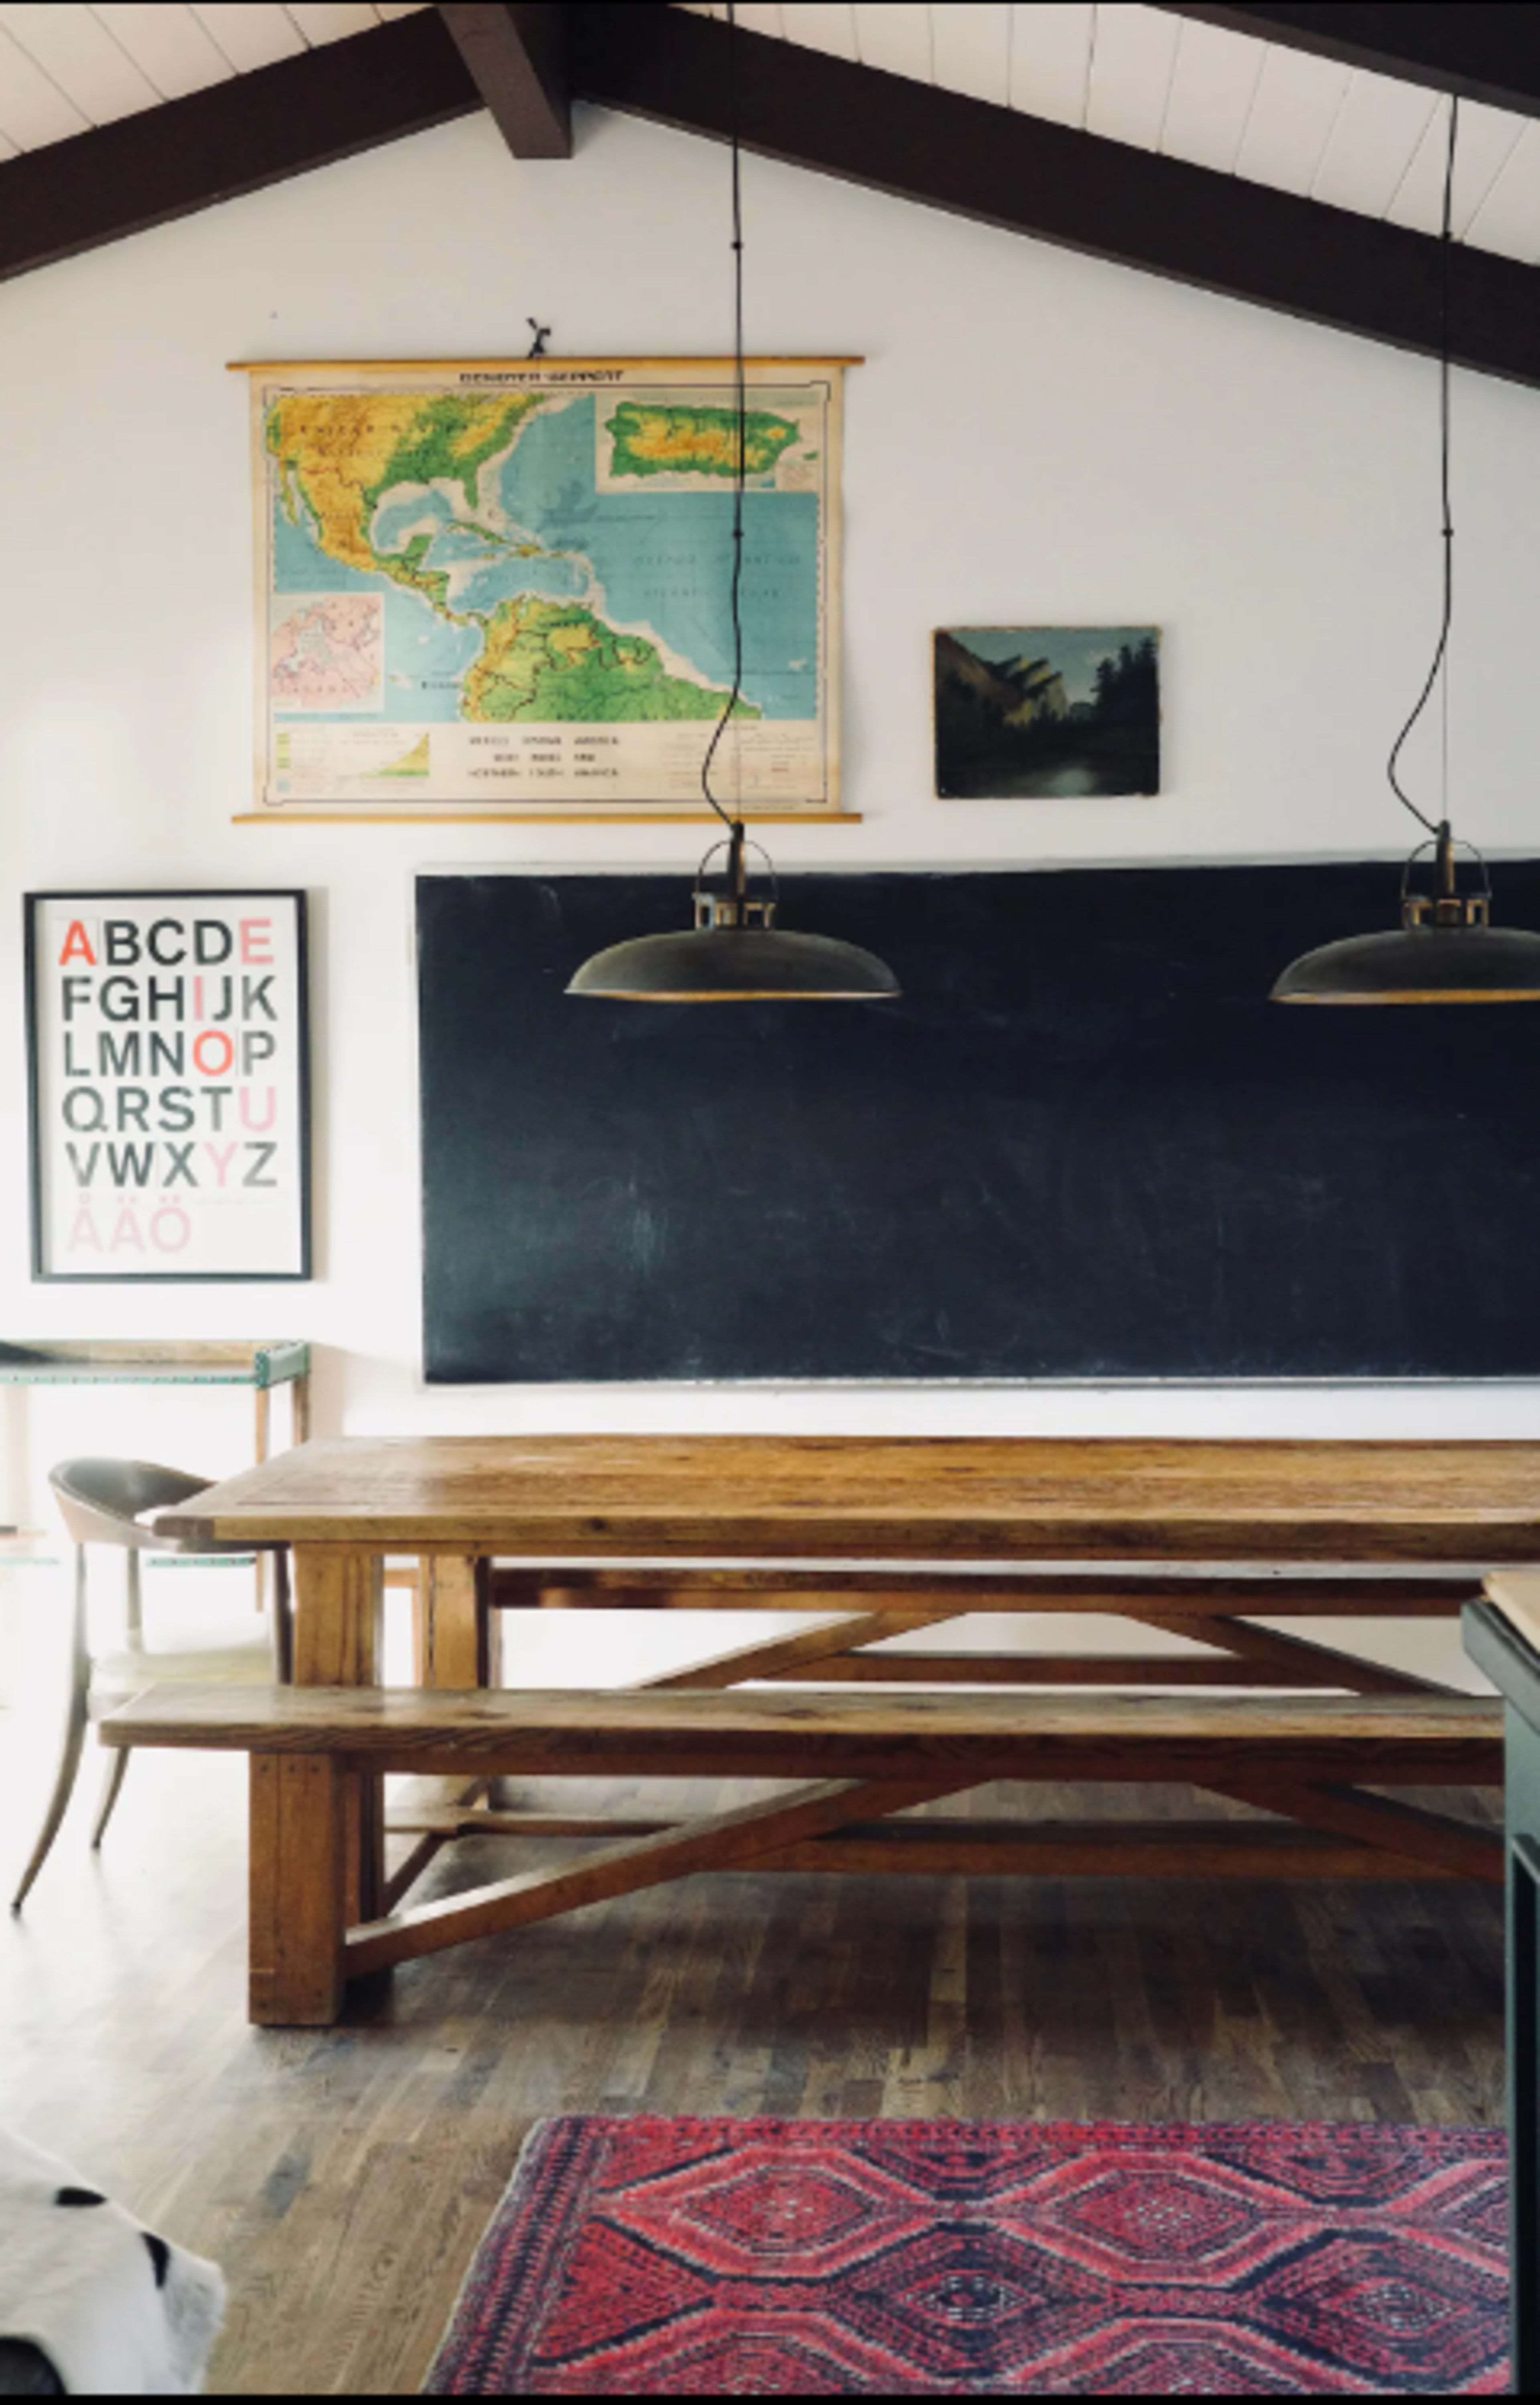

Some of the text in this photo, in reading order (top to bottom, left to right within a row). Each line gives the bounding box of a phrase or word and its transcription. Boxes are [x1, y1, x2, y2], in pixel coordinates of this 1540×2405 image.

[59, 918, 274, 966] ABCDE
[62, 975, 278, 1022] FGHIJK
[64, 1029, 276, 1076] LMNOP
[62, 1085, 276, 1133] QRSTU
[65, 1141, 278, 1187] VWXYZ
